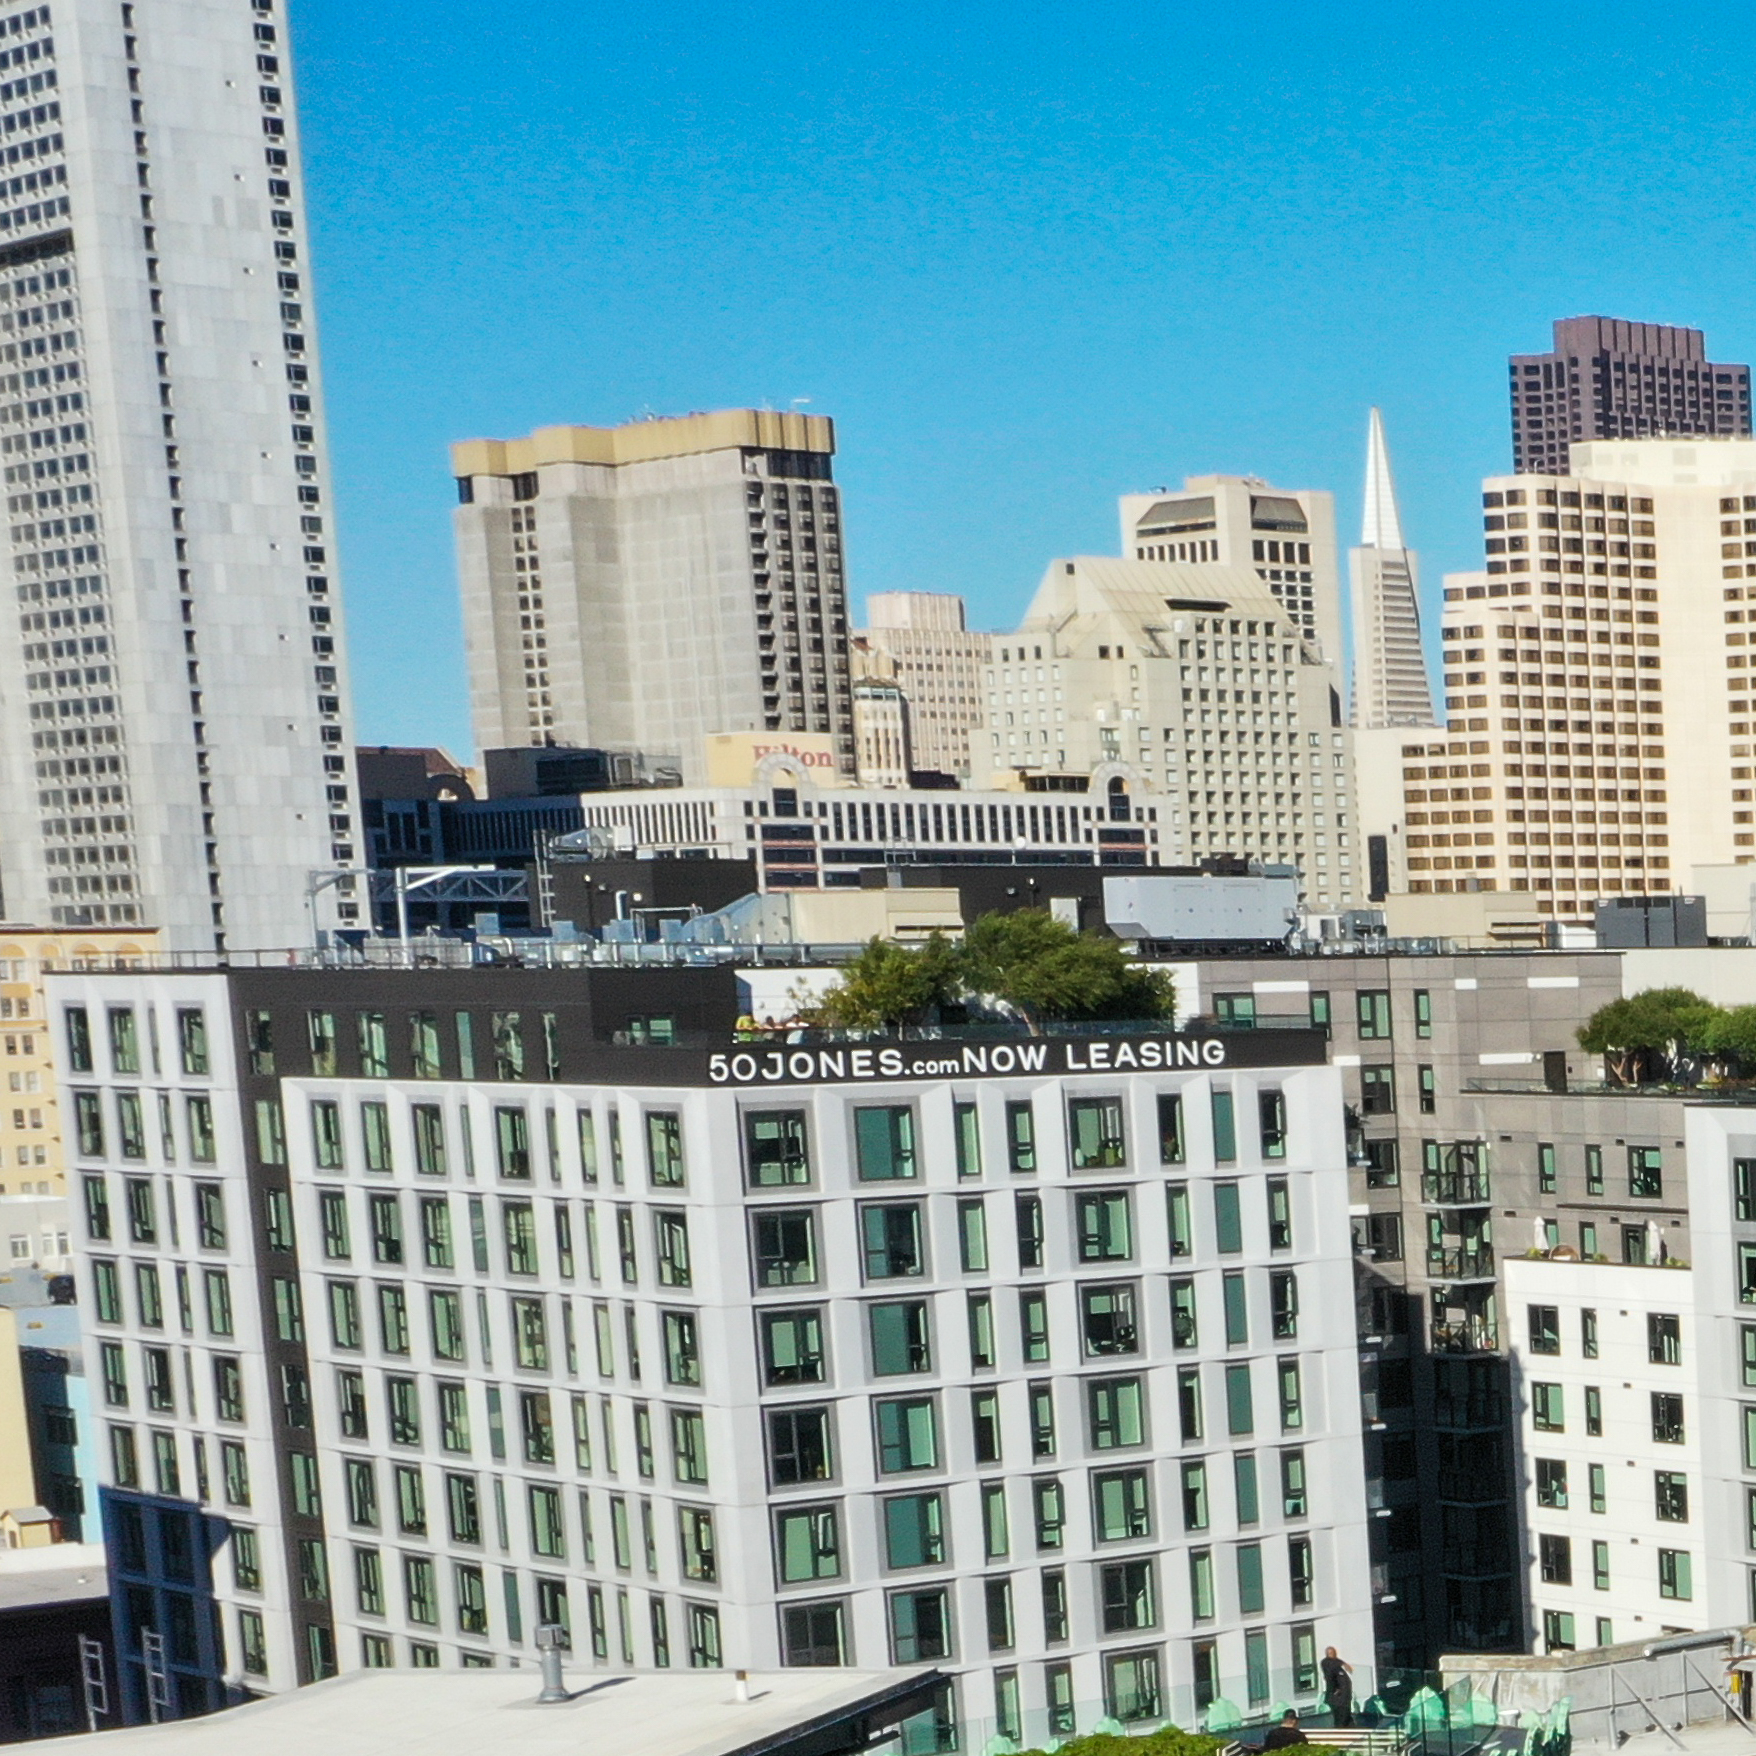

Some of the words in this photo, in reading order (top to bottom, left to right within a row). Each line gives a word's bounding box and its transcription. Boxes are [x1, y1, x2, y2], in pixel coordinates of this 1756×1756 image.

[753, 744, 836, 767] Hton
[709, 1049, 959, 1082] 50JONES.com
[963, 1044, 1047, 1074] NOW
[1066, 1039, 1225, 1070] LEASING
